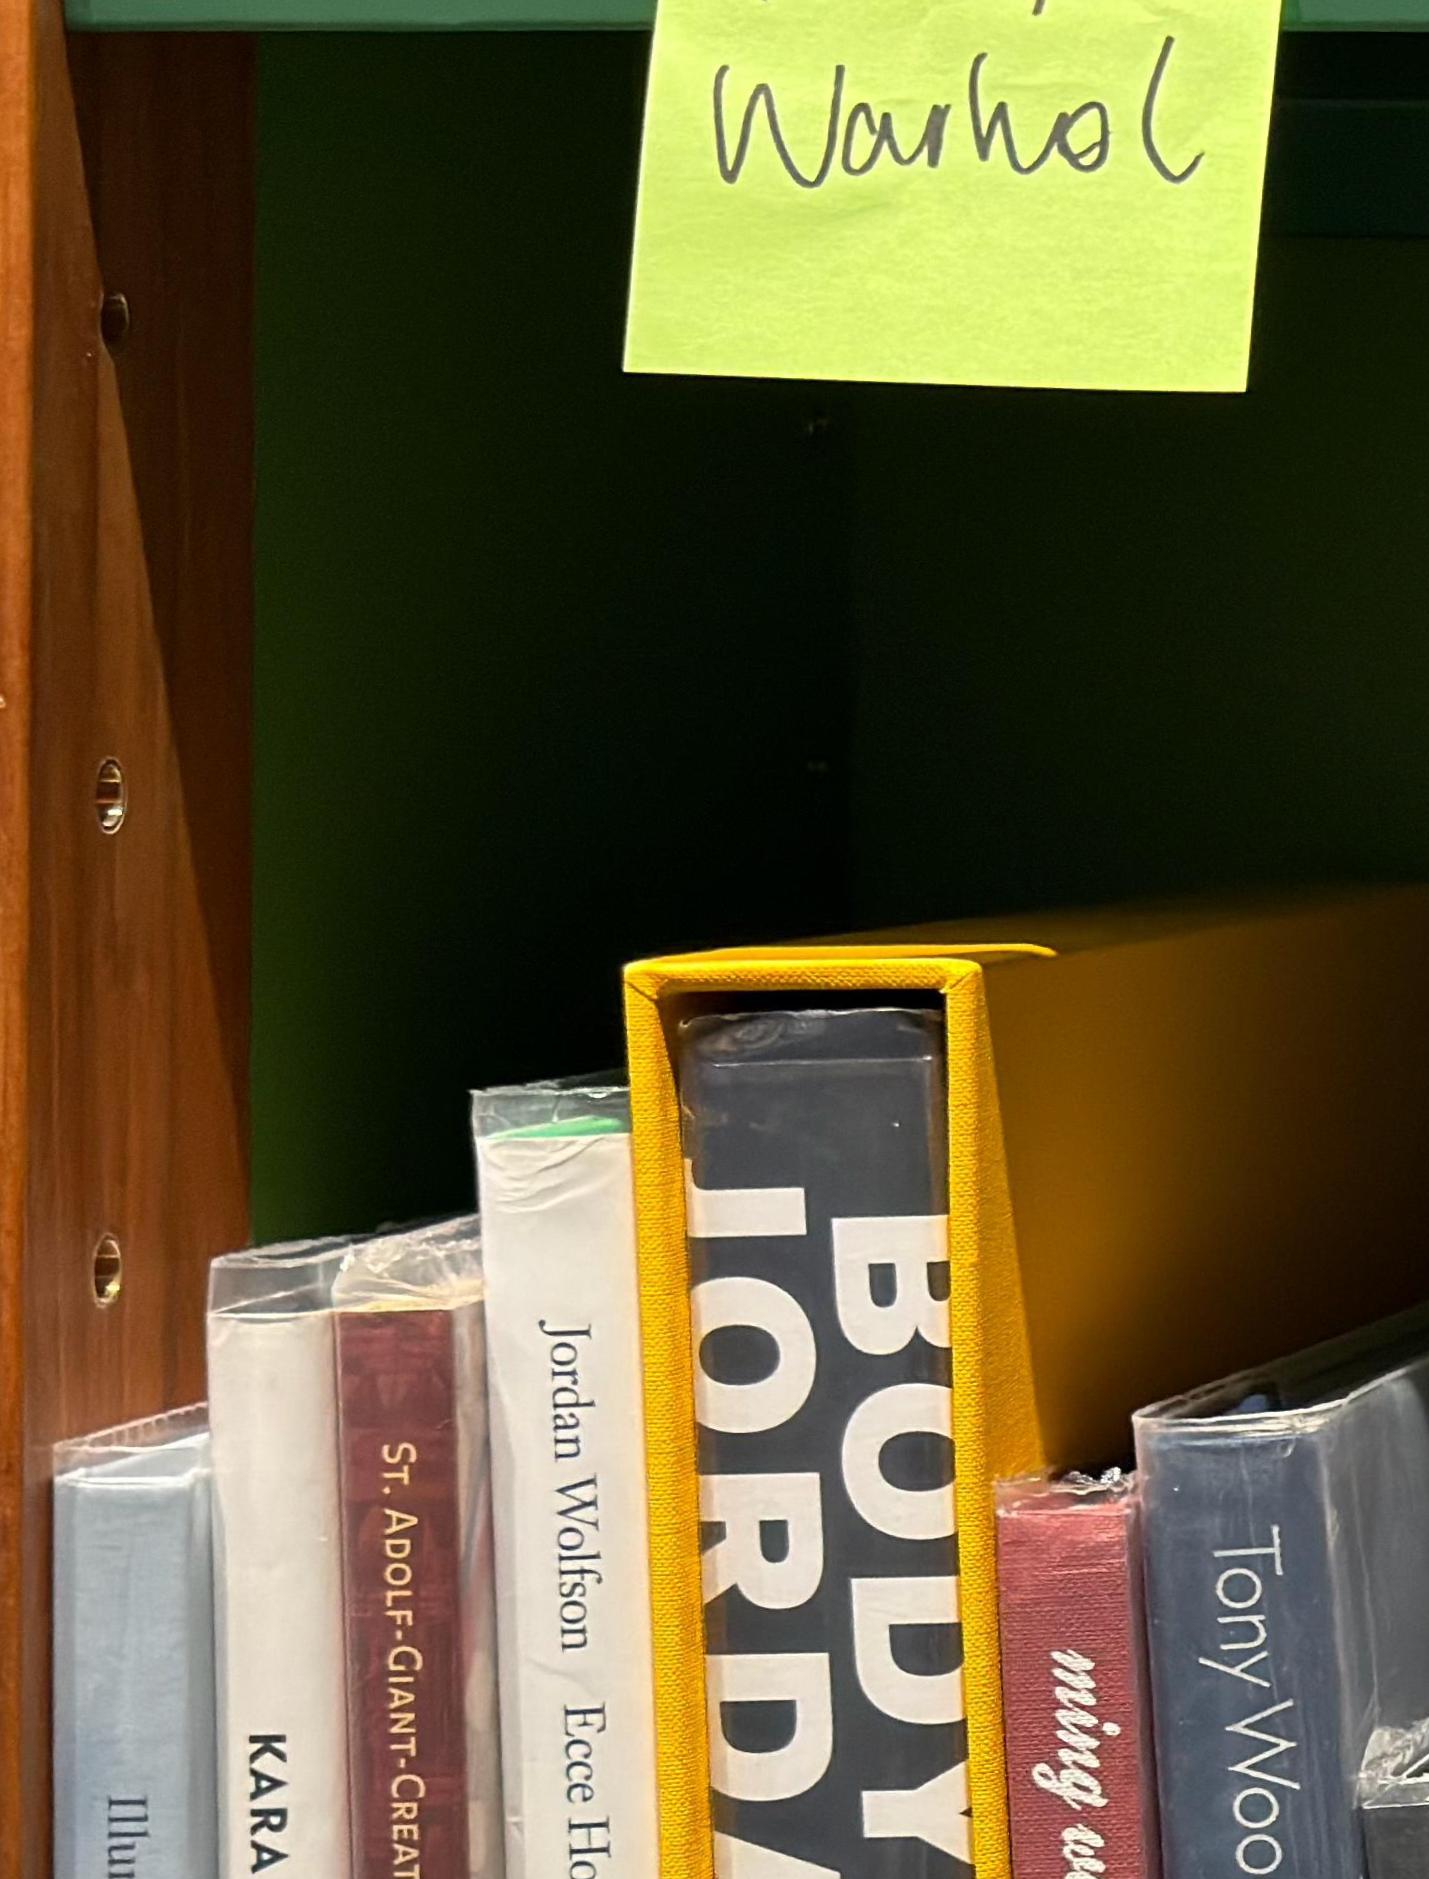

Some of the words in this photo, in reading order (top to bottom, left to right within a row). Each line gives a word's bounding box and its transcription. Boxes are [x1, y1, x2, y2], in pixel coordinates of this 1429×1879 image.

[713, 36, 1205, 189] Warhol
[537, 1318, 597, 1461] Jordan
[554, 1474, 604, 1652] Wolfson
[832, 1215, 977, 1866] BODY
[1198, 1523, 1285, 1688] Tony
[247, 1733, 290, 1875] KARA
[563, 1703, 607, 1804] Ecce
